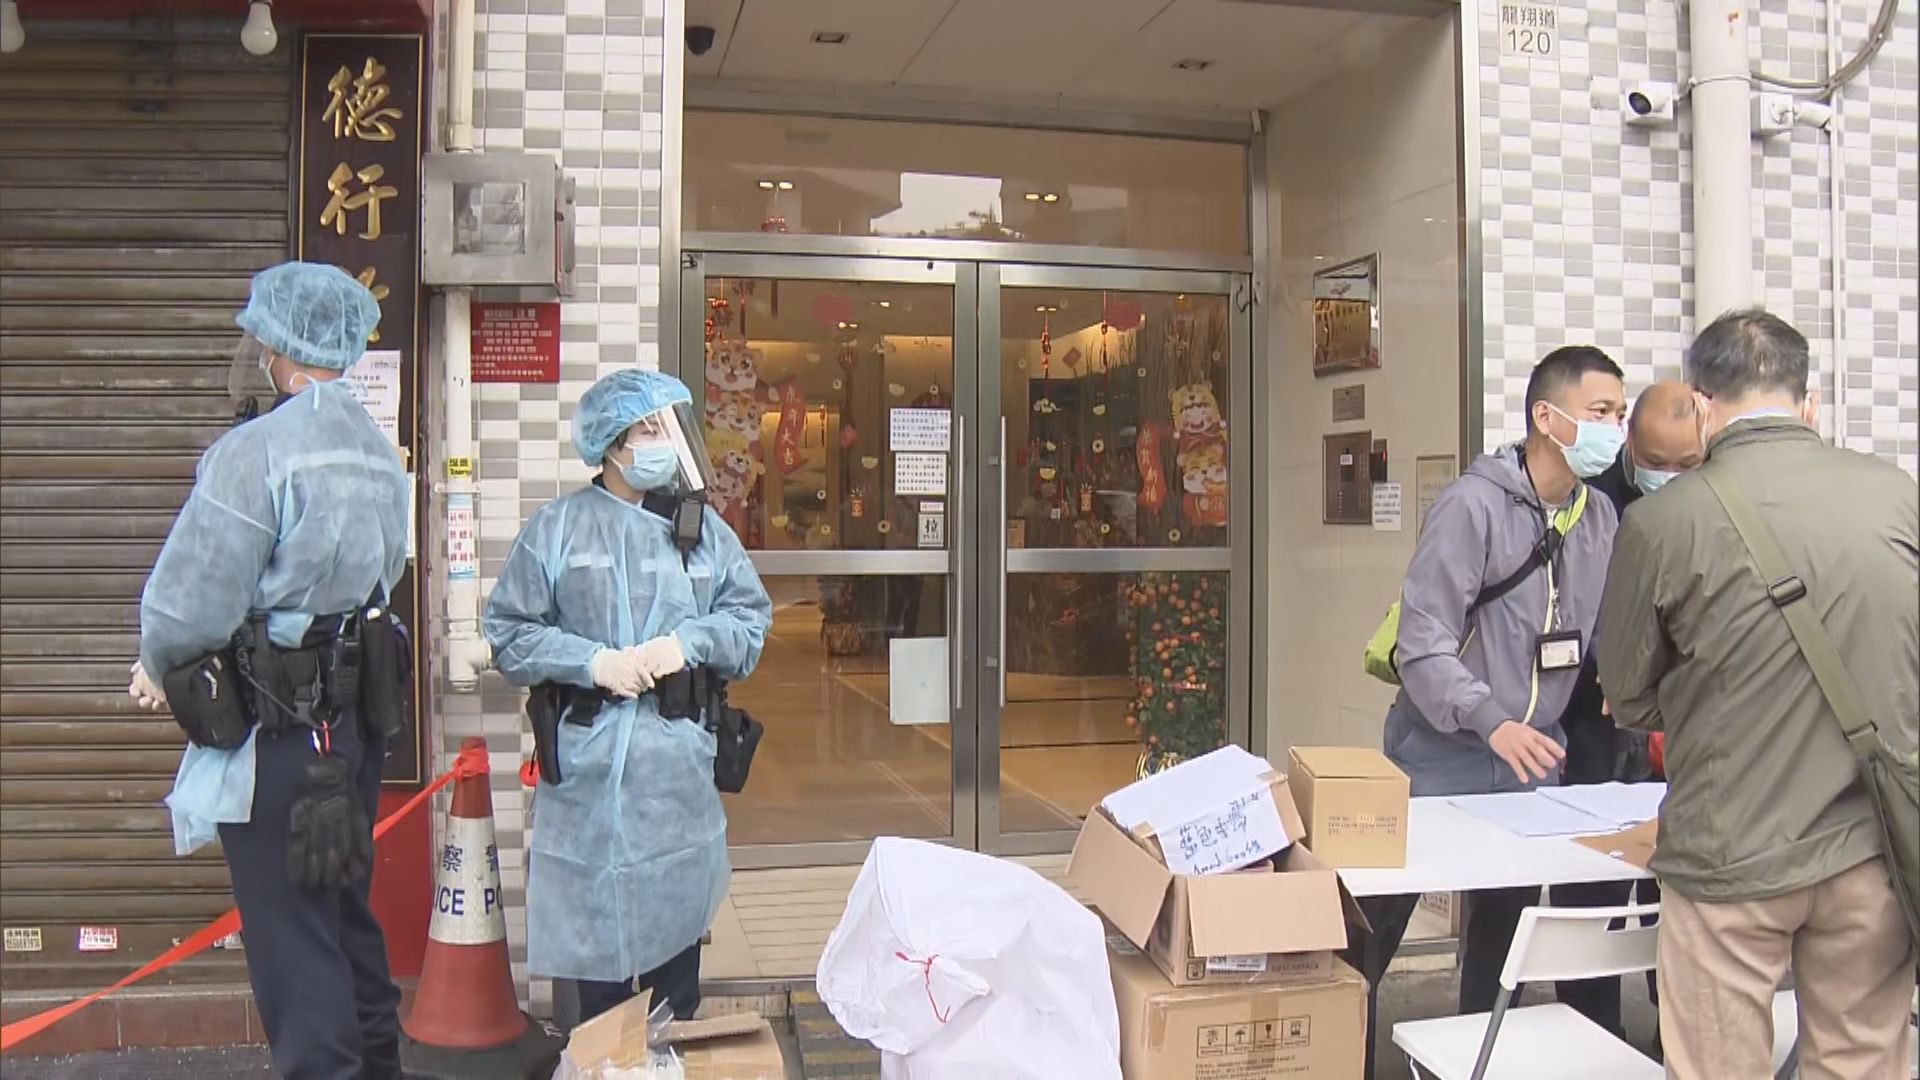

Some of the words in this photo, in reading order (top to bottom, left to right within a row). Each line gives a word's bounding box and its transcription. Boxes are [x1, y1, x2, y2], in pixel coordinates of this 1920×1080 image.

[1502, 5, 1555, 29] 龍翔道
[1508, 28, 1551, 55] 120
